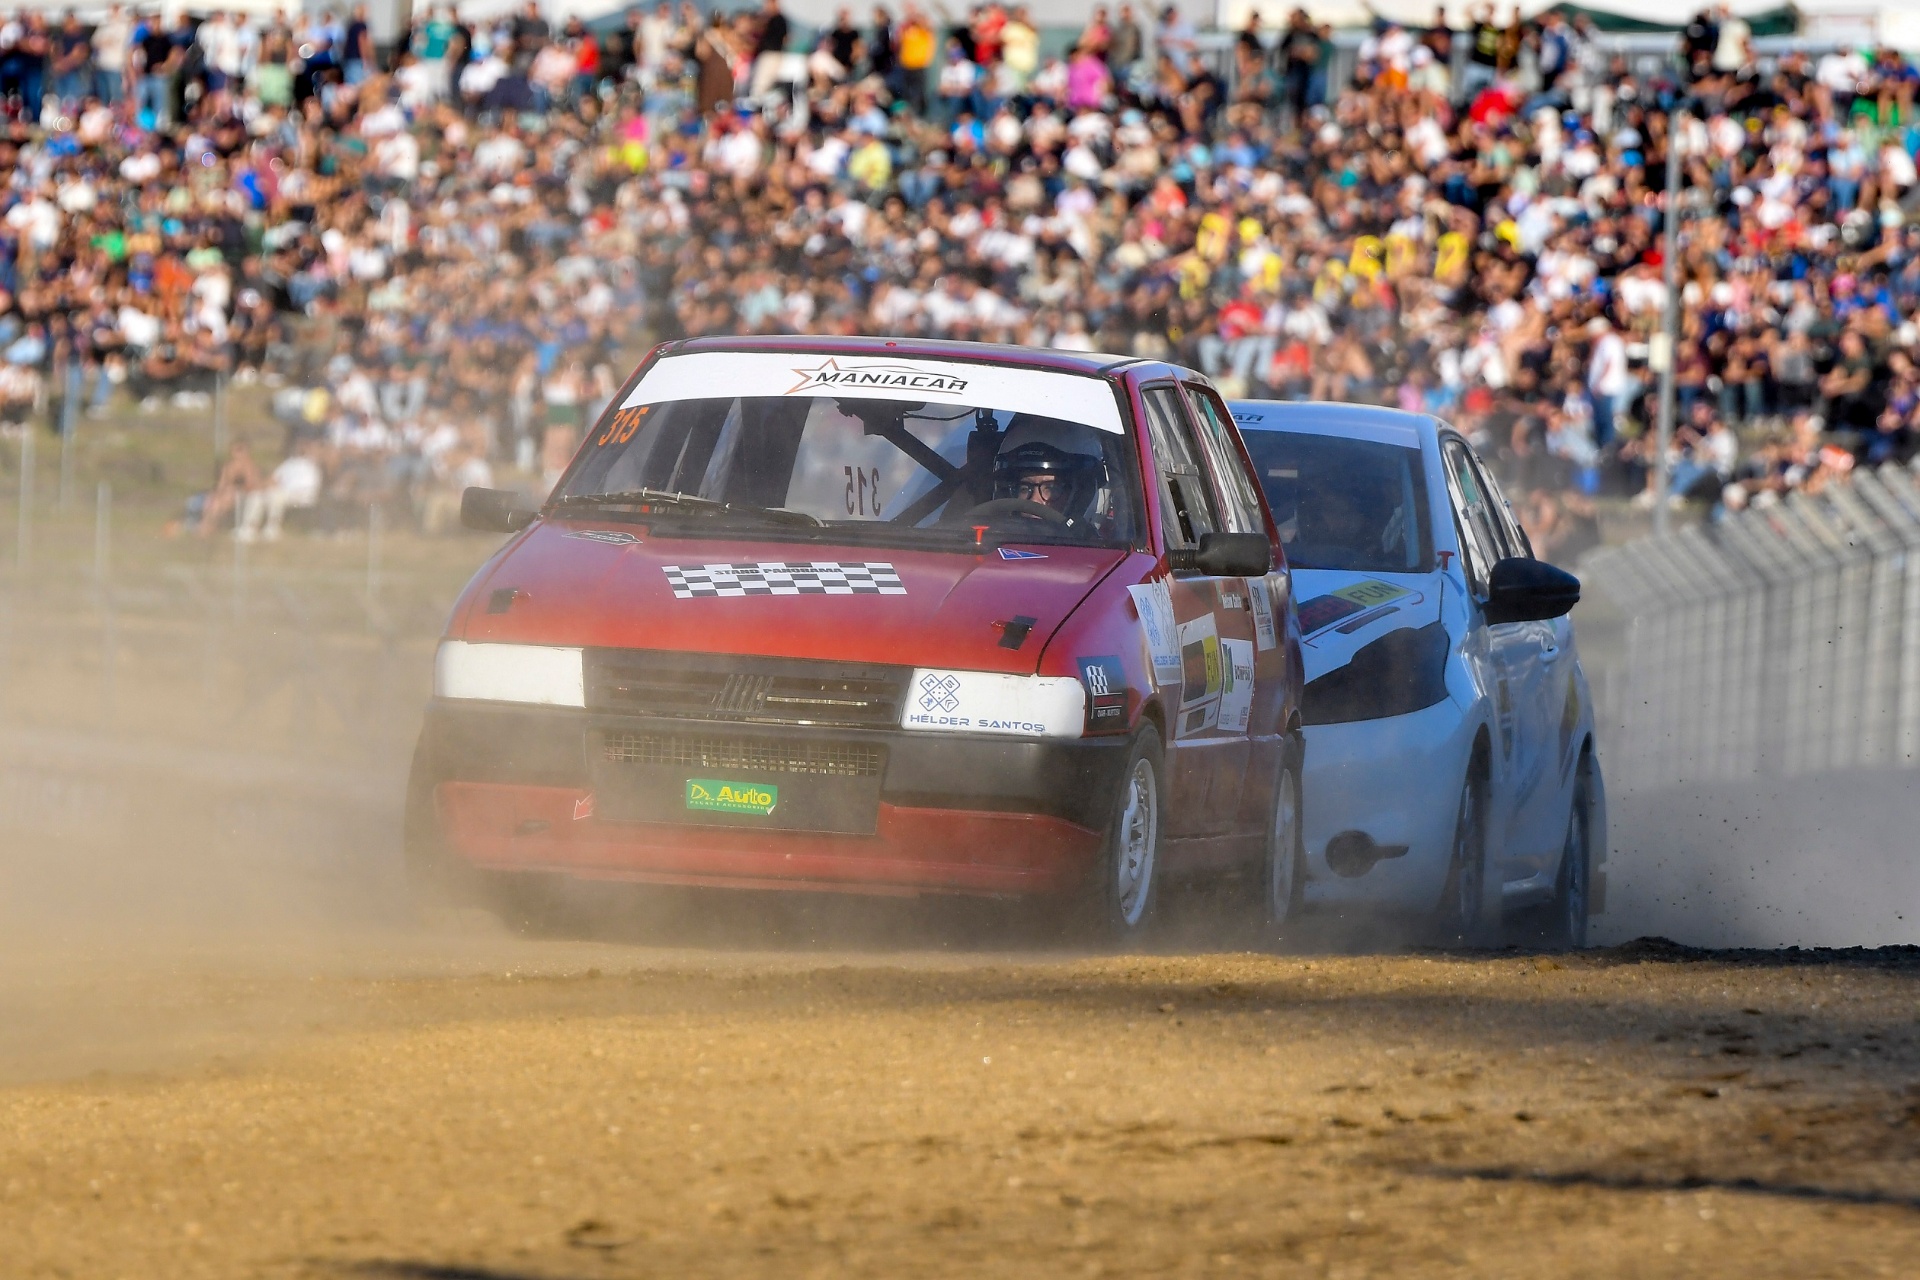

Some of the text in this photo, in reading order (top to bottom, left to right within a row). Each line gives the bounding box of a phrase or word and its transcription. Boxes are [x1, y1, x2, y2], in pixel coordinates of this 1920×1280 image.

[815, 372, 968, 391] MANIACAR
[598, 406, 649, 446] 315
[763, 567, 844, 575] PANORAMA
[1346, 583, 1400, 604] FUN
[910, 713, 1046, 733] HÉLDER SANTOS
[717, 786, 772, 806] Auto
